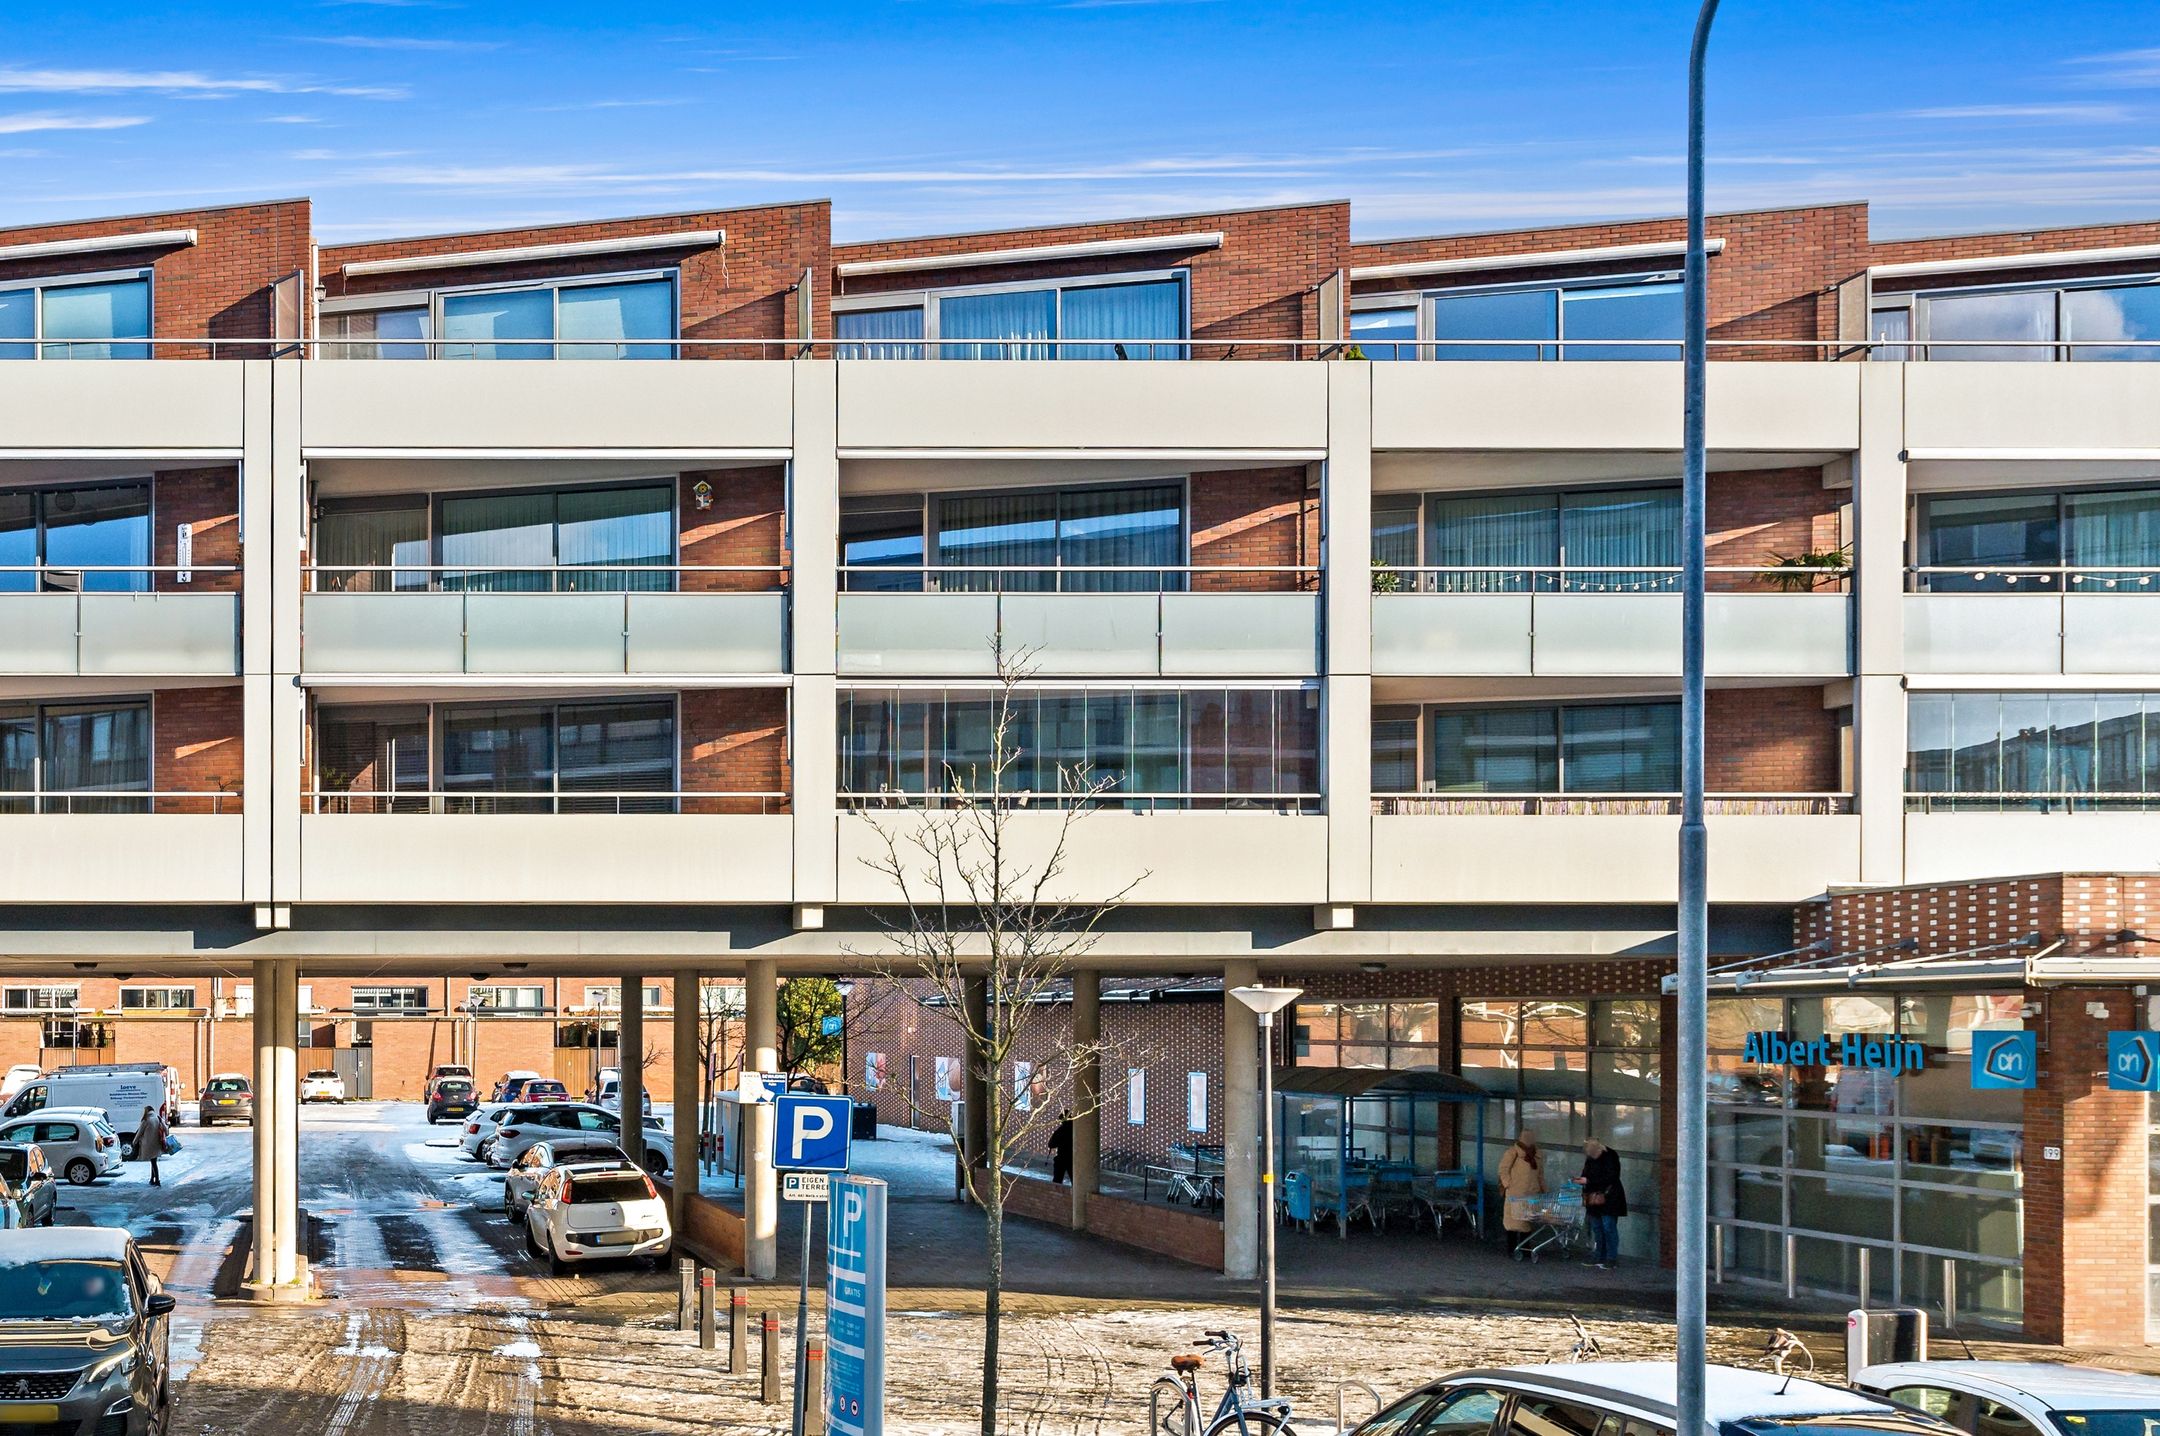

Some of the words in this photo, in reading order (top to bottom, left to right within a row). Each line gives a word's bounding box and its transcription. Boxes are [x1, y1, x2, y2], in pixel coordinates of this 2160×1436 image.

[1743, 1031, 1831, 1067] Albert
[1842, 1032, 1924, 1078] Heijn
[792, 1105, 834, 1160] P
[2044, 1149, 2060, 1158] 199
[789, 1178, 797, 1188] P
[843, 1190, 862, 1238] P
[844, 1286, 861, 1299] GRATIS
